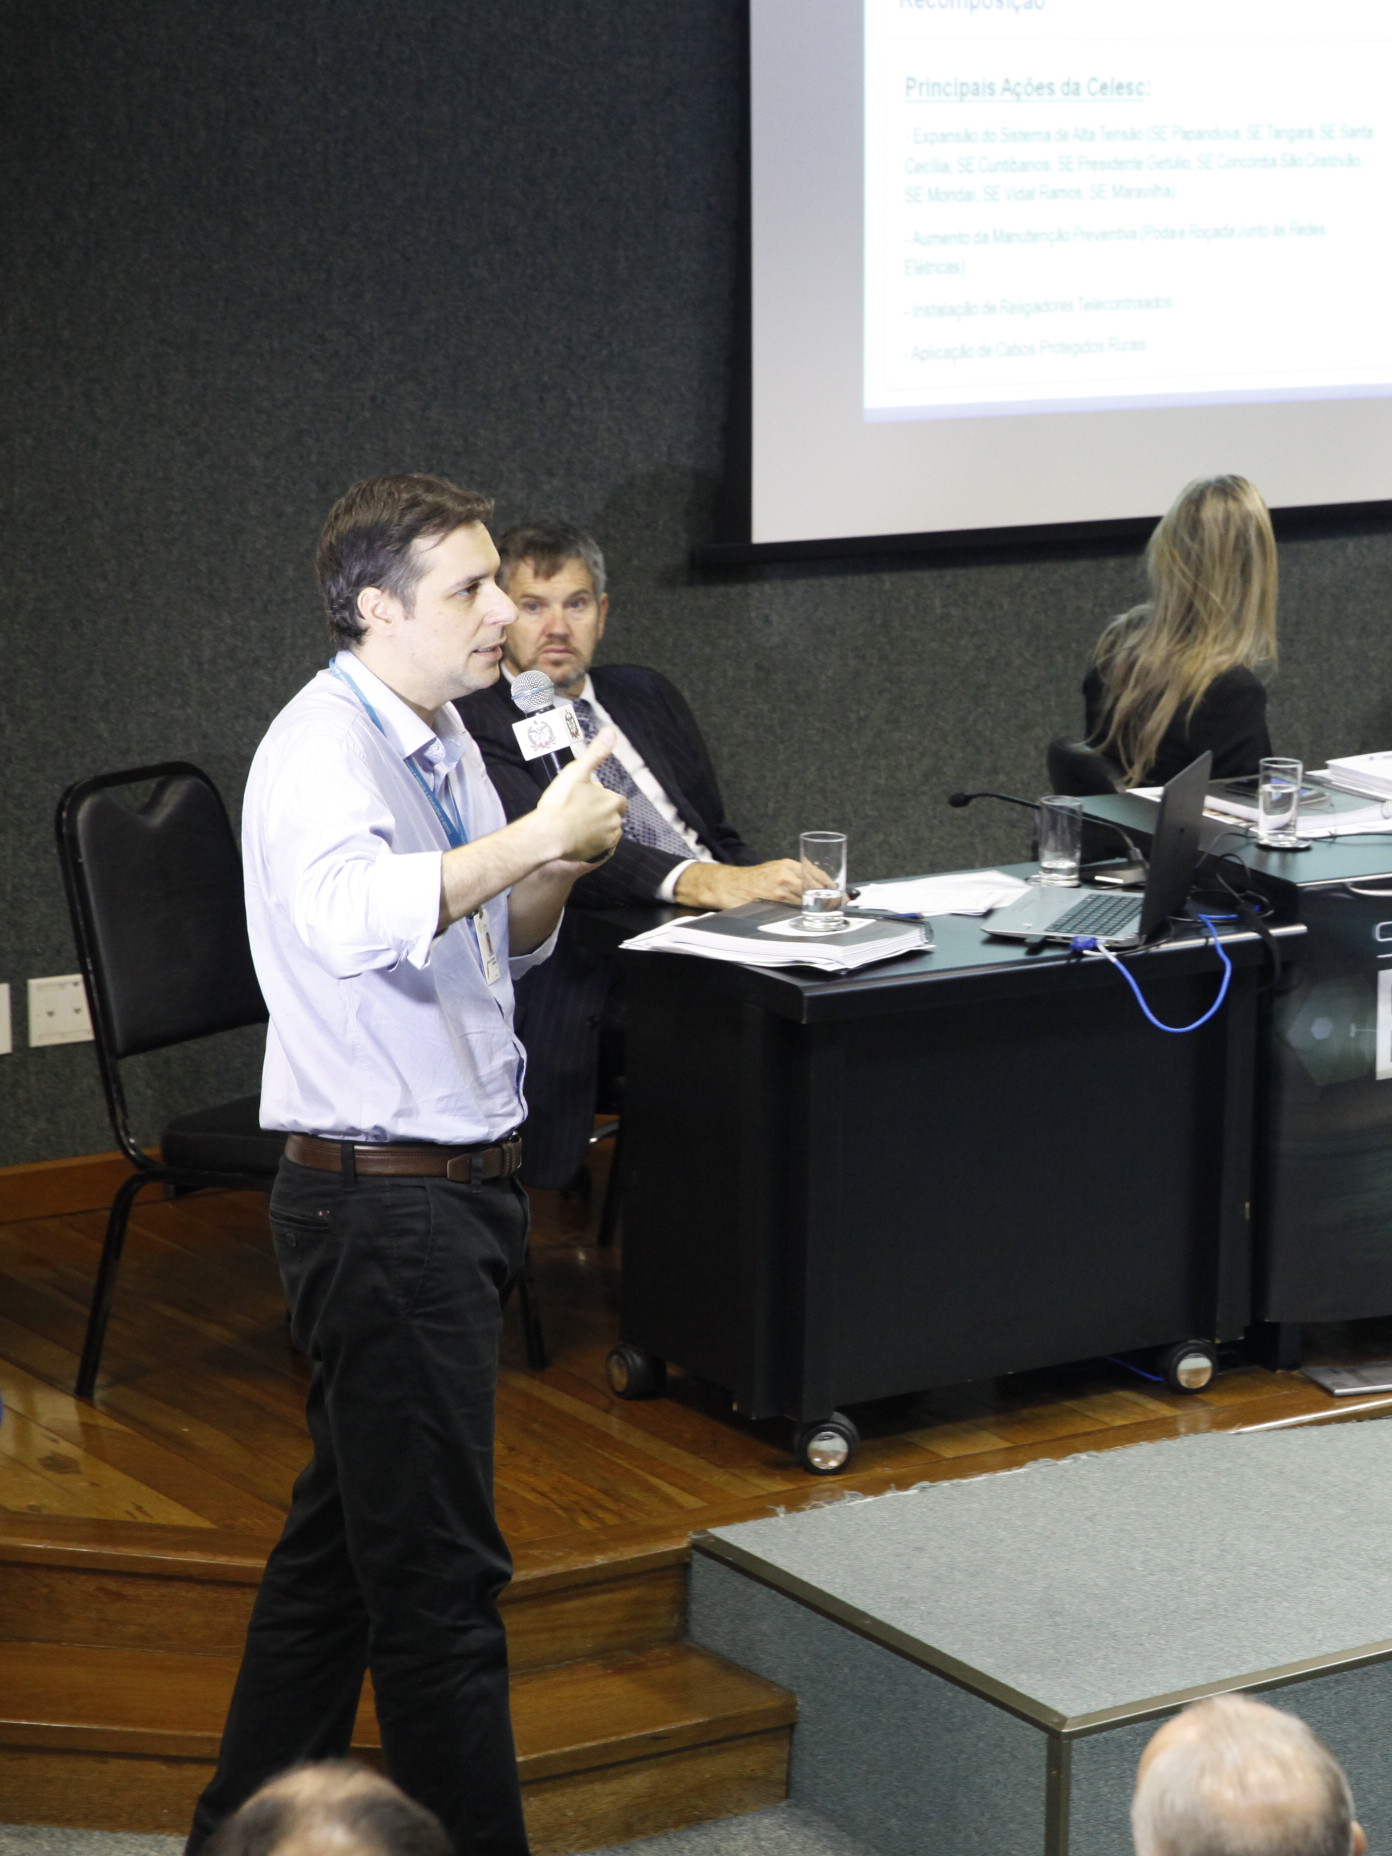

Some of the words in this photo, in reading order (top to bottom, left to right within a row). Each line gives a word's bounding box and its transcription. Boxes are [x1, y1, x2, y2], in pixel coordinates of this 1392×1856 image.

[906, 75, 997, 99] Principais
[1000, 76, 1056, 99] Ações
[1060, 76, 1082, 98] da
[1086, 76, 1153, 98] Celesc:
